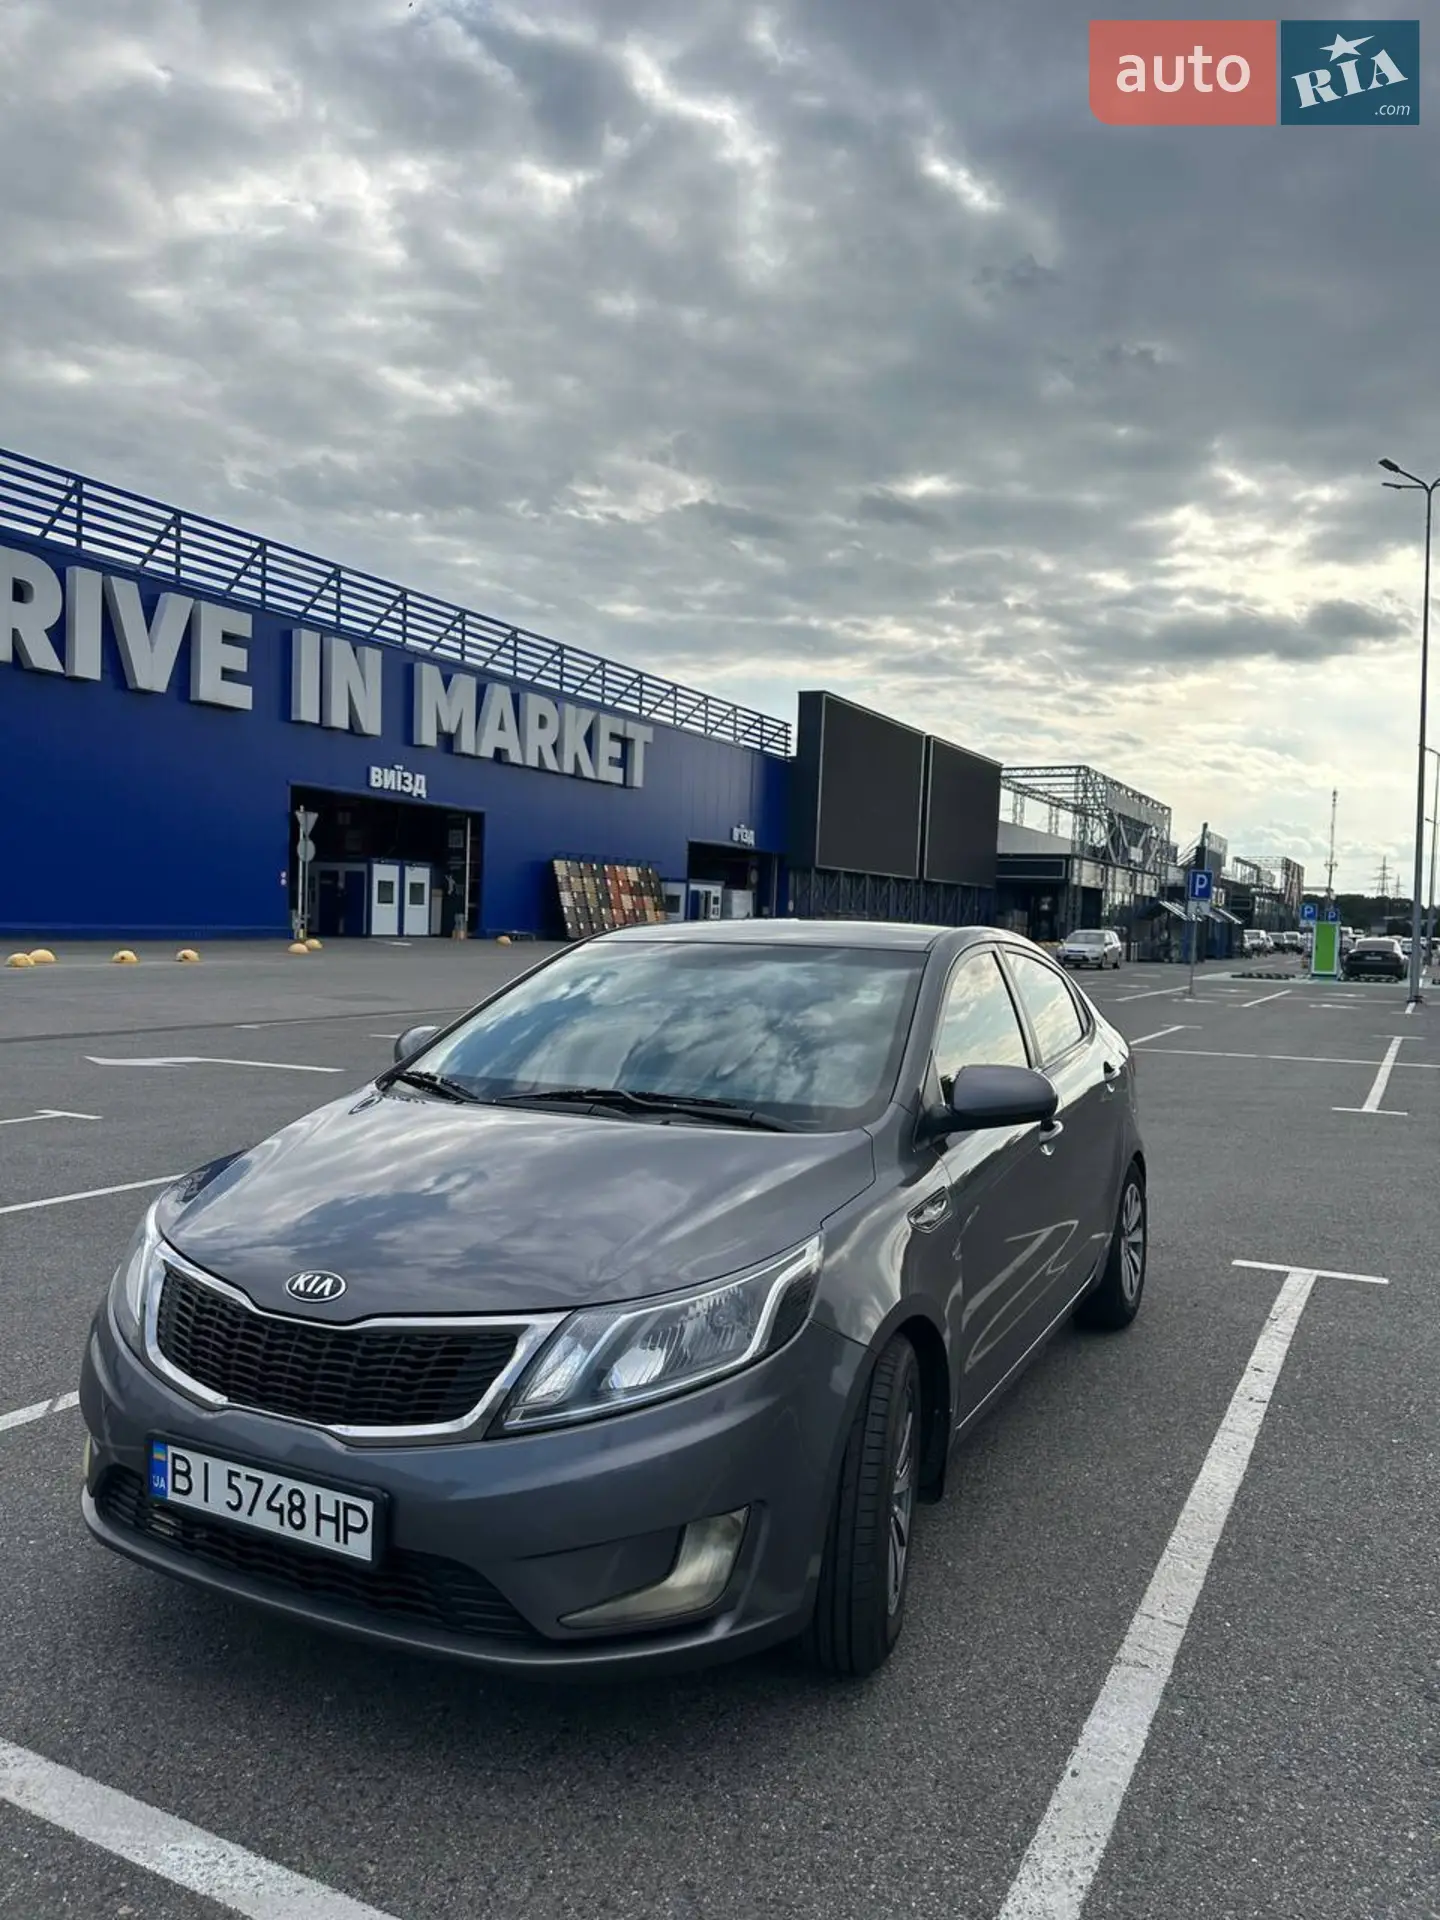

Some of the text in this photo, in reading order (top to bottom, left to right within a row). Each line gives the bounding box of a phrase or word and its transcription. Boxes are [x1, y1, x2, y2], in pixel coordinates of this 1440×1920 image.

[0, 545, 653, 788] RIVE IN MARKET
[1195, 873, 1208, 896] P
[290, 1274, 335, 1297] KIA
[152, 1474, 166, 1489] UA
[225, 1468, 307, 1532] 5748
[315, 1492, 370, 1545] HP
